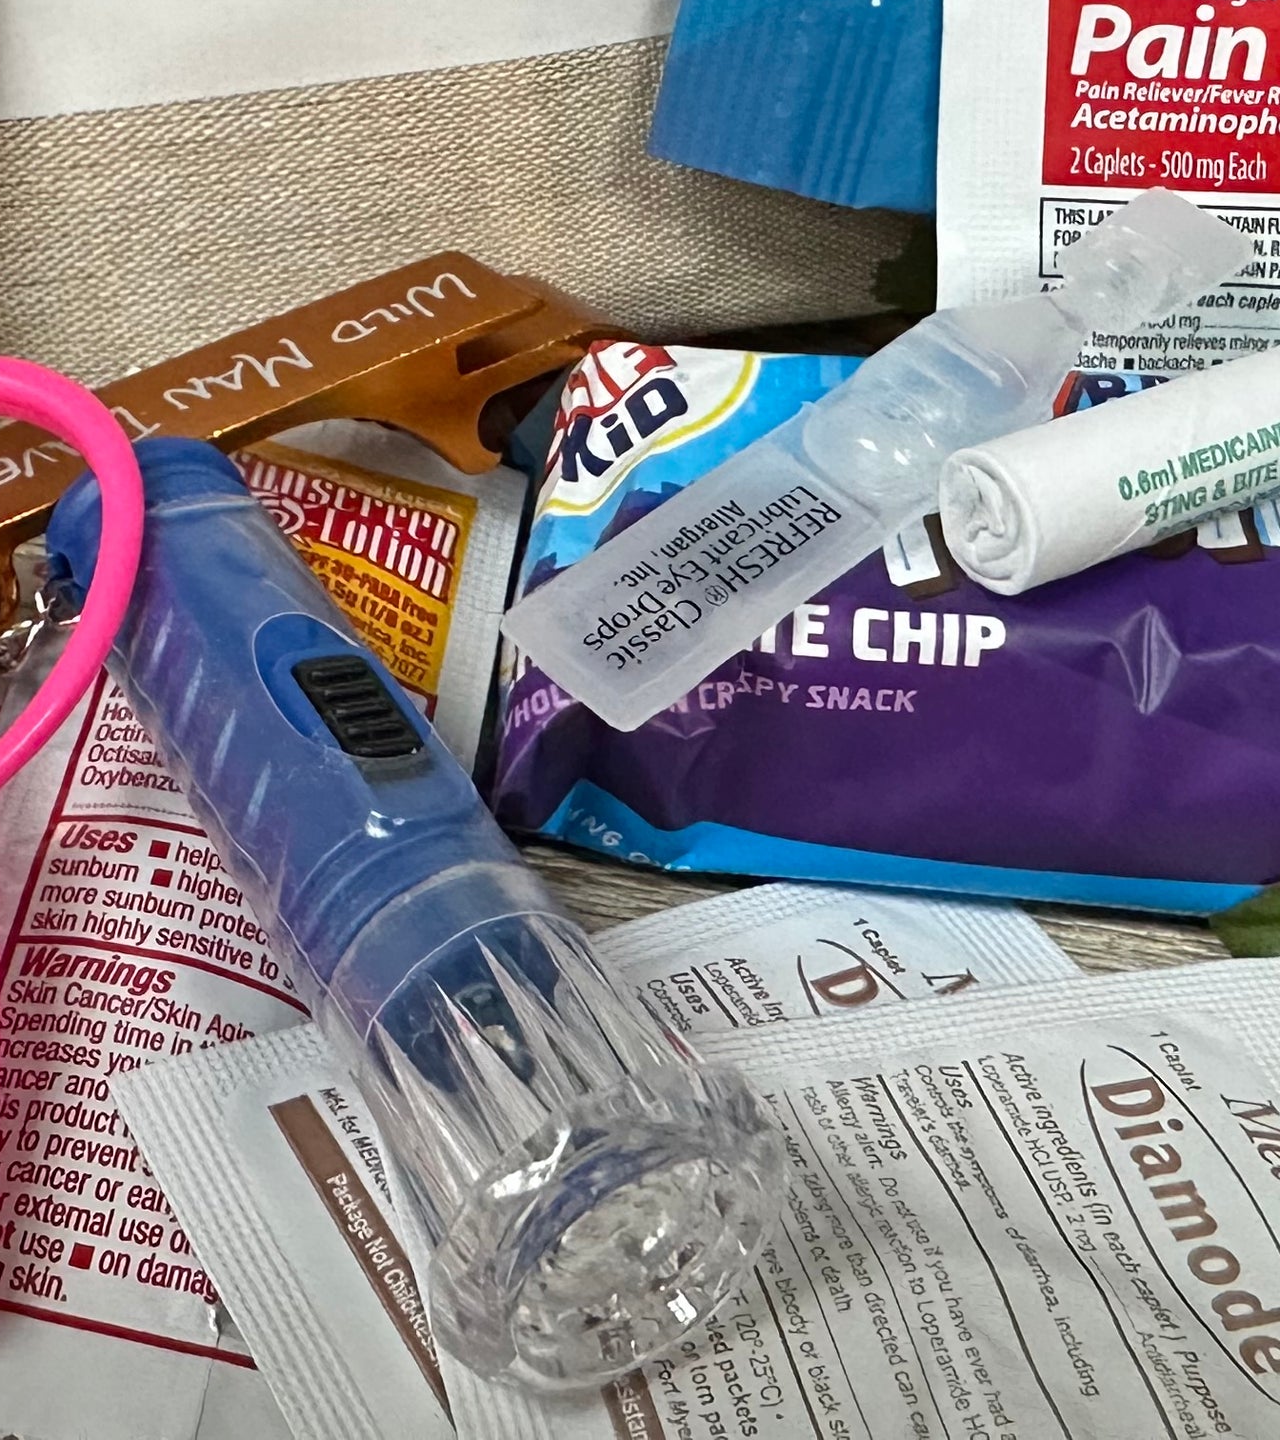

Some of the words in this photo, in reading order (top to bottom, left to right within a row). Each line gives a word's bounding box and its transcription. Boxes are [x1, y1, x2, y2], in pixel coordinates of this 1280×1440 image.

[1070, 4, 1267, 82] Pain
[1075, 80, 1119, 101] Pain
[1123, 82, 1265, 105] Reliever/Fever
[1070, 147, 1082, 174] 2
[1084, 147, 1145, 182] Caplets
[1160, 151, 1193, 179] 500
[1196, 159, 1225, 187] mg
[1229, 152, 1267, 181] Each
[1055, 208, 1085, 226] THIS
[1212, 479, 1227, 501] &
[1233, 459, 1278, 493] BITE
[702, 485, 820, 565] Lubricant
[320, 507, 447, 599] Lotion
[656, 559, 709, 595] Eye
[583, 591, 666, 651] Drops
[606, 599, 703, 670] Classic
[853, 606, 1007, 668] CHIP
[806, 684, 918, 714] SNACK
[60, 824, 138, 853] Uses
[40, 883, 98, 905] more
[31, 908, 79, 932] skin
[82, 911, 153, 946] highly
[156, 927, 253, 970] sensitive
[259, 954, 279, 981] to
[20, 946, 176, 997] Warnings
[7, 979, 58, 1005] Skin
[63, 982, 201, 1032] Cancer/Skin
[113, 1020, 165, 1052] time
[171, 1032, 193, 1057] in
[25, 1100, 120, 1137] product
[851, 1077, 908, 1160] Warnings
[16, 1128, 40, 1151] to
[44, 1132, 139, 1173] prevent
[6, 1160, 92, 1196] cancer
[94, 1177, 124, 1203] or
[326, 1172, 375, 1241] Package
[20, 1231, 65, 1263] use
[99, 1249, 131, 1279] on
[118, 1217, 164, 1248] use
[1001, 1051, 1042, 1104] Active
[1032, 1100, 1098, 1201] ingredients
[1182, 1347, 1232, 1434] Purpose
[10, 1262, 68, 1302] skin.
[864, 1293, 908, 1366] directed
[895, 1371, 918, 1406] can
[917, 1300, 971, 1411] Loperamide
[925, 1260, 953, 1293] you
[946, 1297, 973, 1342] have
[965, 1347, 992, 1386] ever
[984, 1391, 1014, 1427] had
[1054, 1316, 1100, 1398] including
